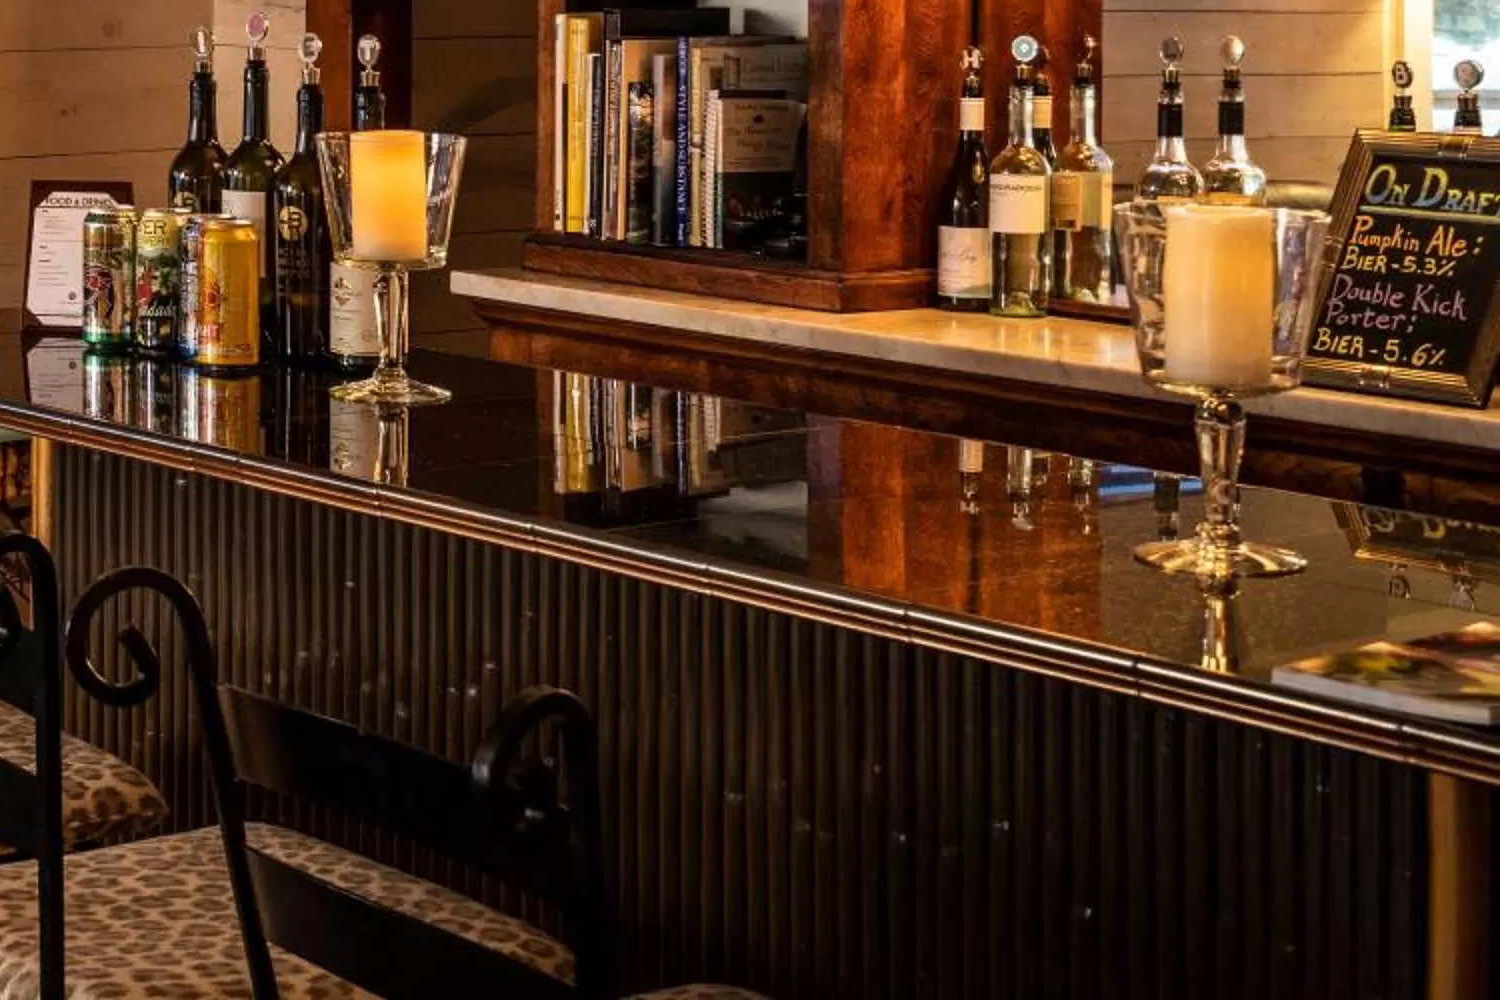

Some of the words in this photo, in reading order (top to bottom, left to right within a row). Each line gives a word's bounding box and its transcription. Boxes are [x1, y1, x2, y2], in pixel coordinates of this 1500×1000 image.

[1349, 215, 1420, 253] Pumpkin
[1331, 273, 1405, 308] Double
[1411, 283, 1468, 321] Kick
